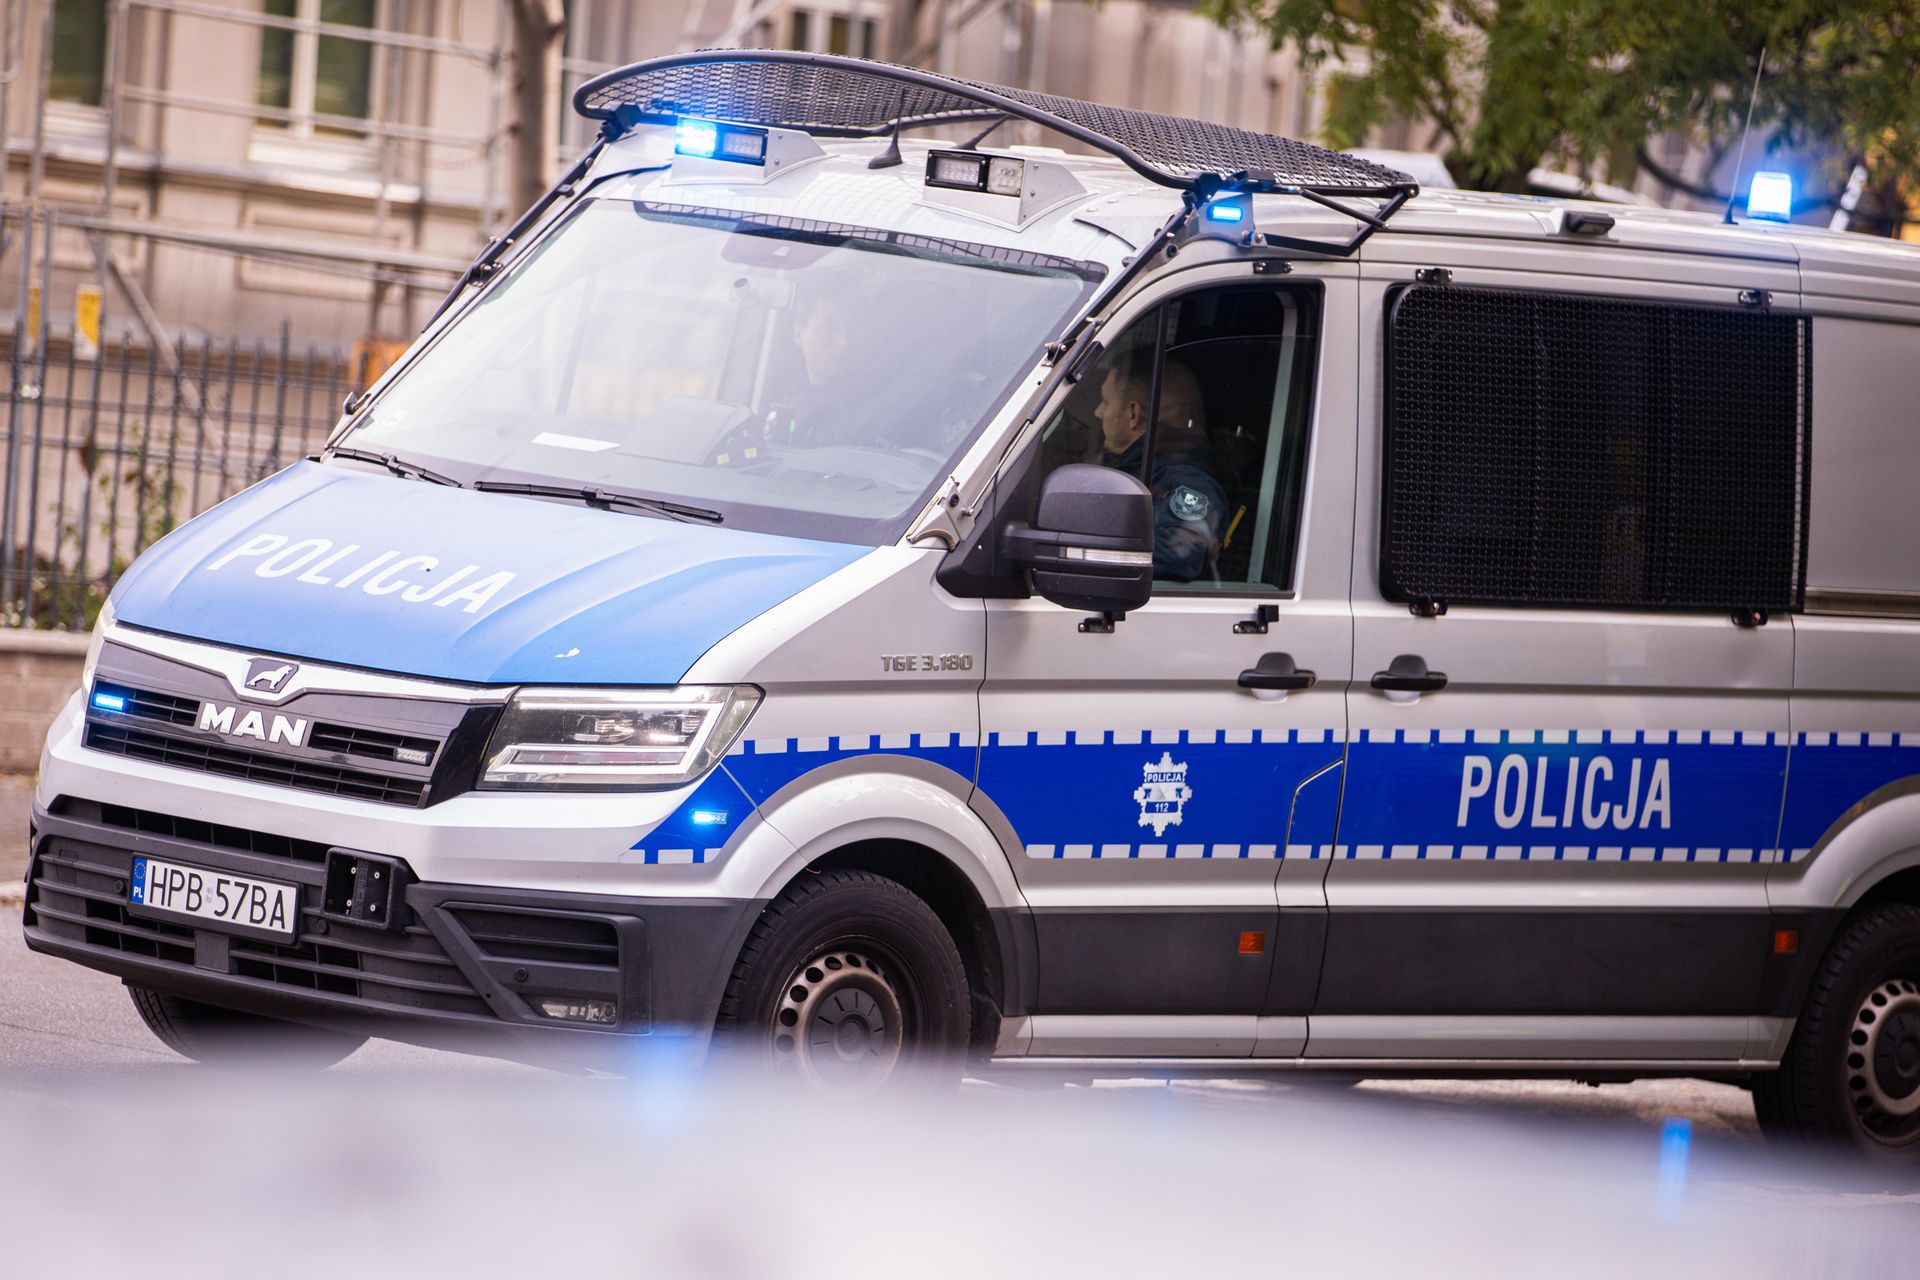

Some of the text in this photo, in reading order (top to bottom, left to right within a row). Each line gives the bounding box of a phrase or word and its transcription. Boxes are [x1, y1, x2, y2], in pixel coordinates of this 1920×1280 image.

[206, 533, 517, 614] POLICJA
[881, 654, 974, 672] TGE 3.180
[199, 702, 308, 747] MAN
[1147, 773, 1182, 783] POLICJA
[1456, 753, 1671, 830] POLICJA
[1155, 802, 1169, 813] 112
[133, 886, 143, 898] PL
[149, 864, 286, 930] HPB 57BA
